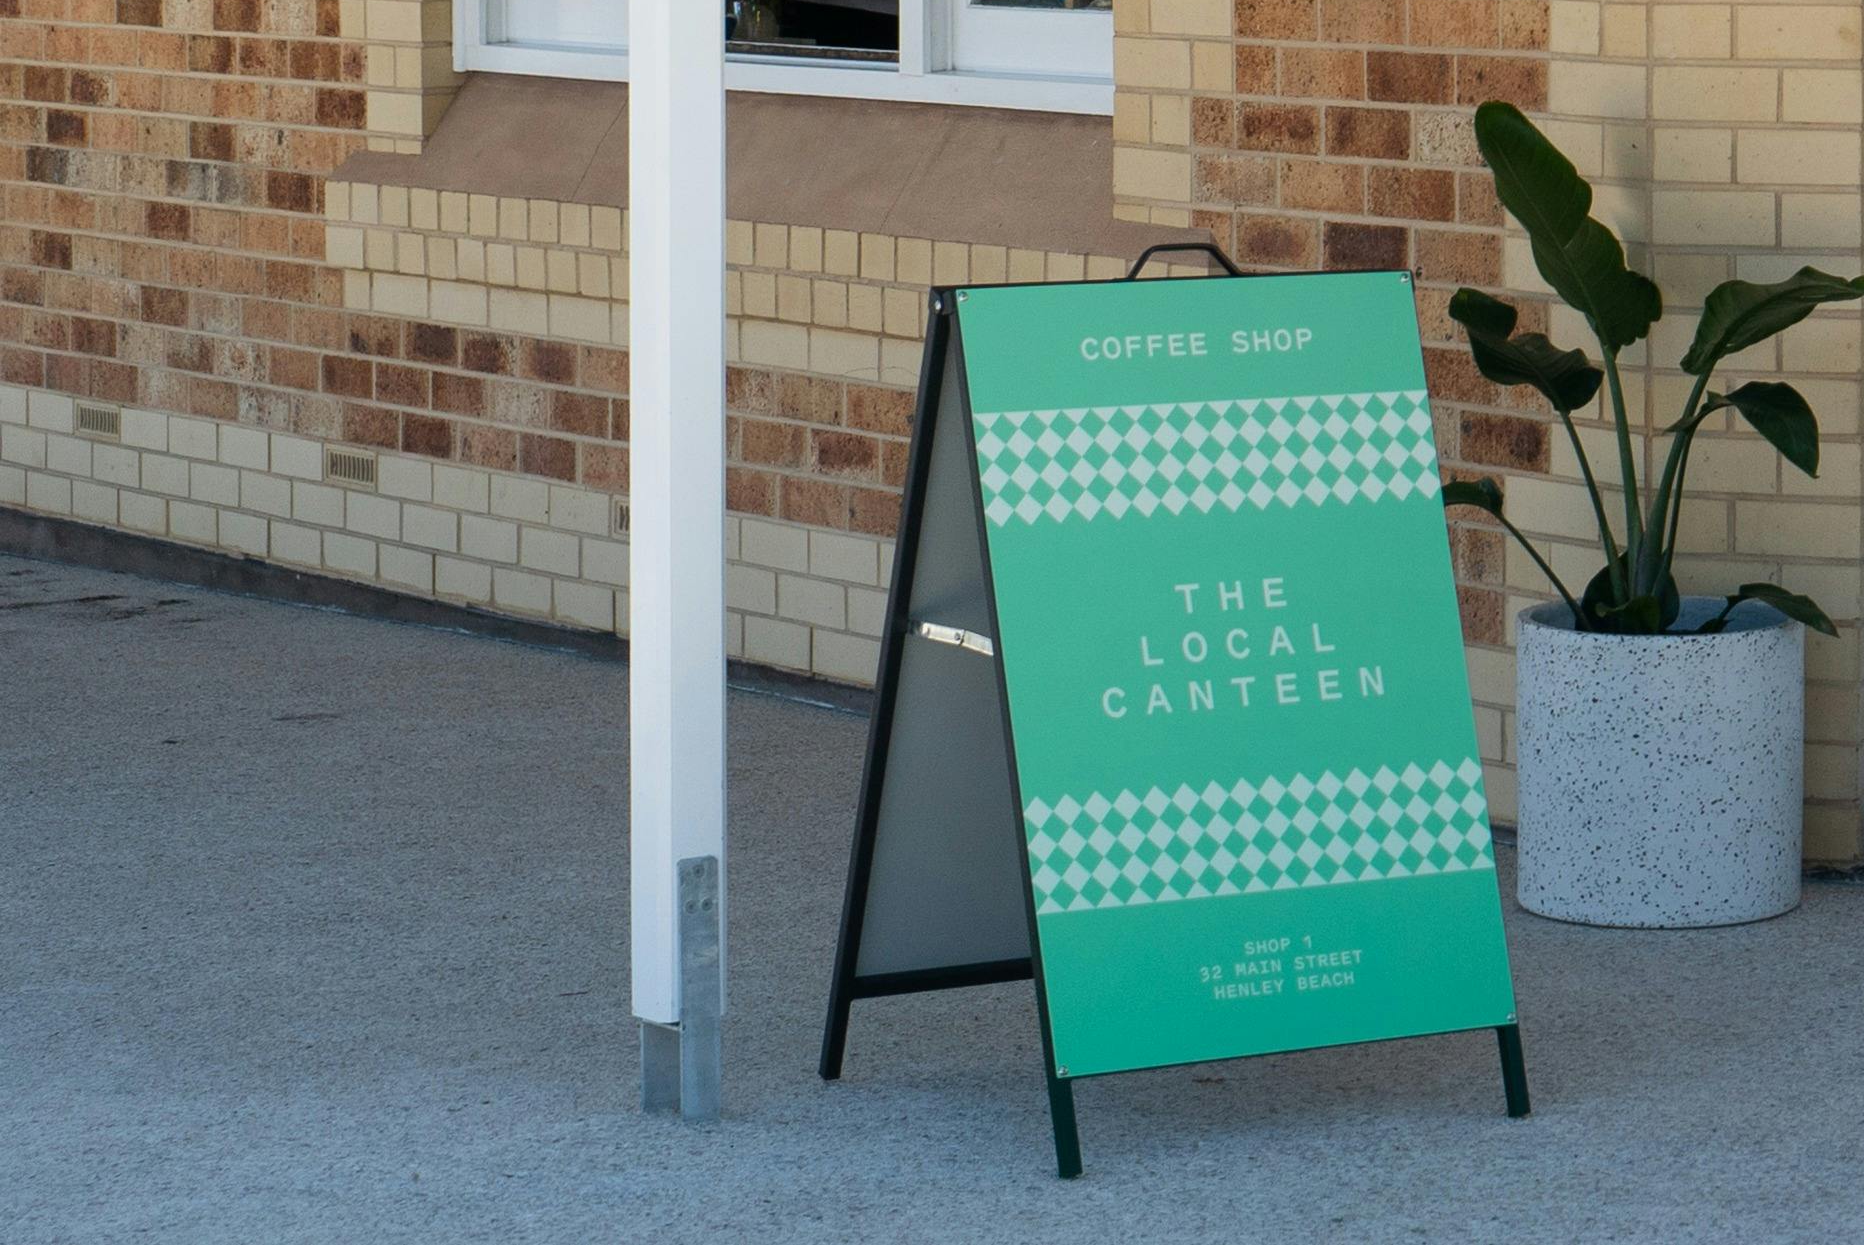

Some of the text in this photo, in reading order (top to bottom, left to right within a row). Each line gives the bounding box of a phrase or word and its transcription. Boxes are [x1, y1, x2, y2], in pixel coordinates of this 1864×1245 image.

[1079, 327, 1312, 361] COFFEE SHOP
[1173, 577, 1287, 614] THE
[1140, 622, 1335, 667] LOCAL
[1101, 666, 1385, 719] CANTEEN
[1244, 935, 1313, 956] SHOP 1
[1199, 950, 1362, 983] 32 MAIN STREET
[1215, 972, 1355, 1000] HENLEY BEACH
